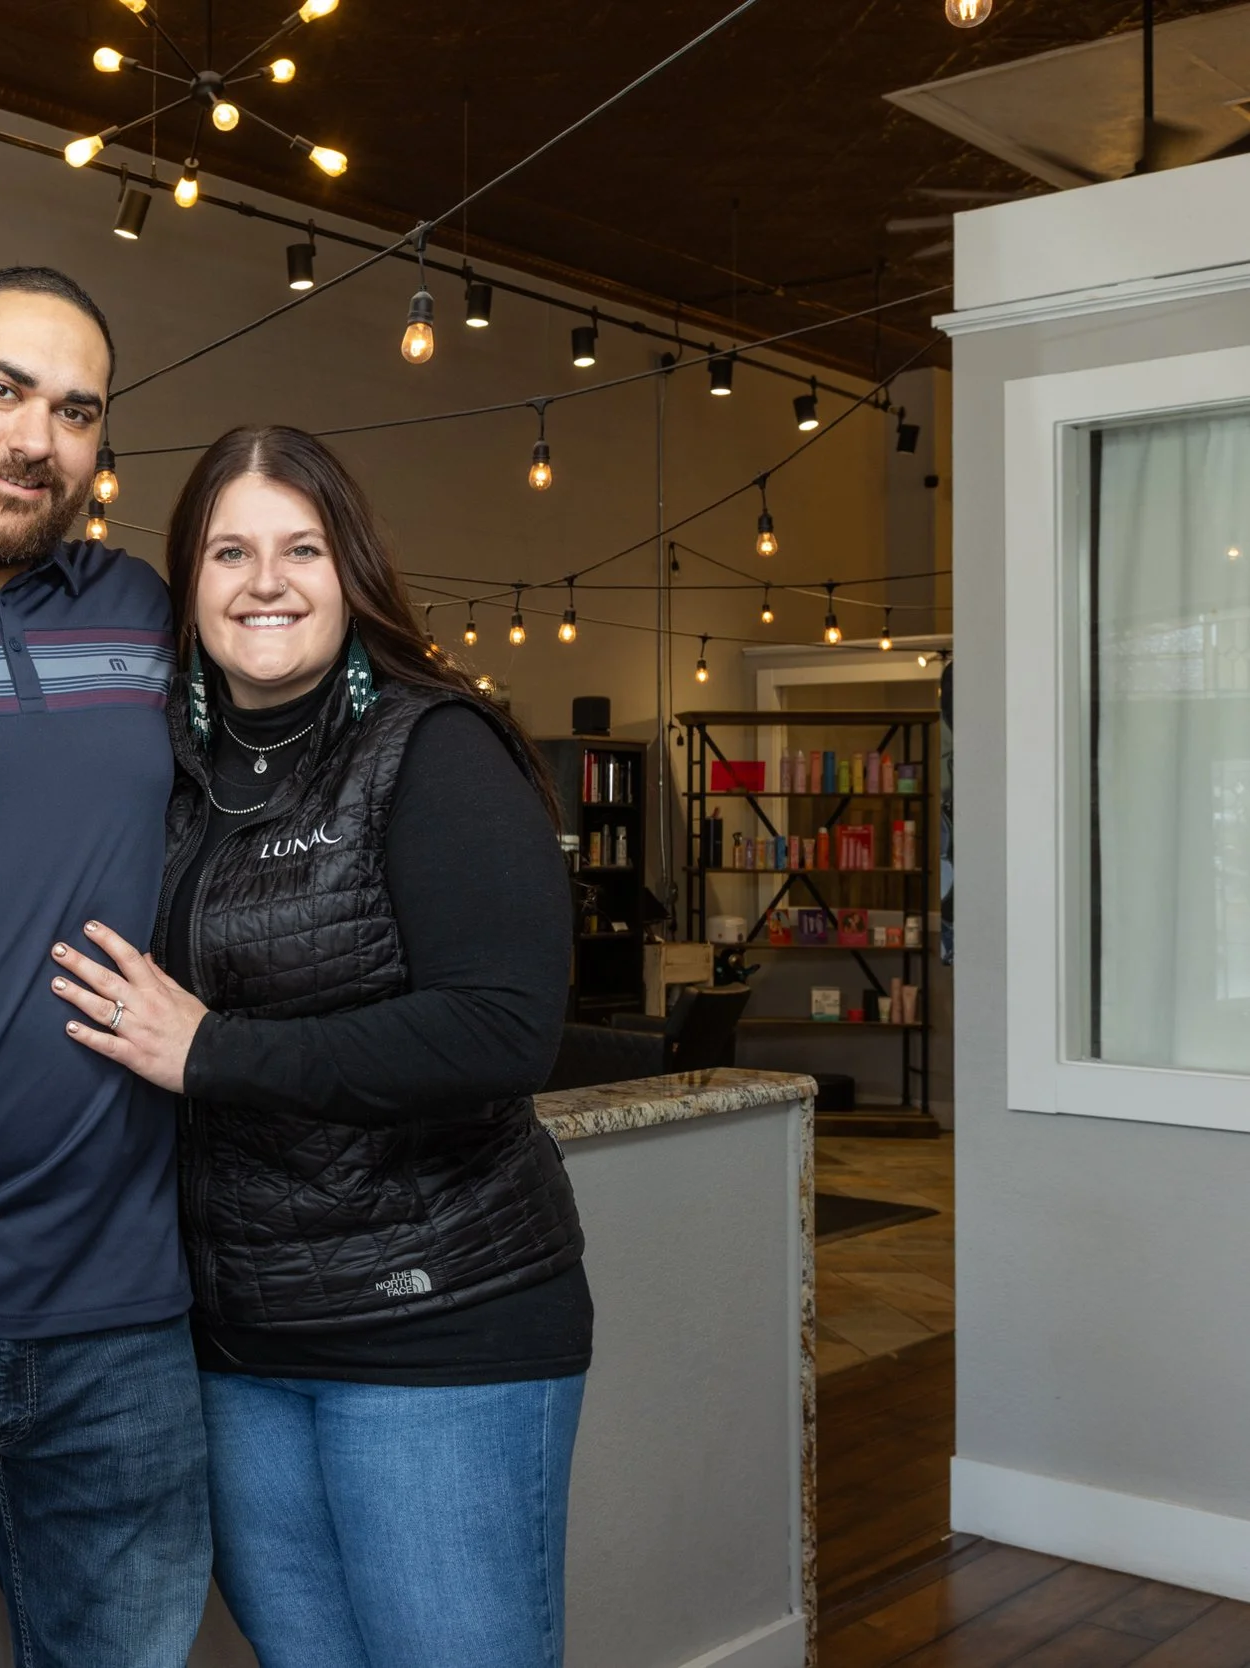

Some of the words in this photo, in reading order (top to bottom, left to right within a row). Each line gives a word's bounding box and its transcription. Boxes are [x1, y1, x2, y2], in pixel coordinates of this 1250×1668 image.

[390, 1270, 411, 1280] THE
[375, 1277, 412, 1291] NORTH
[387, 1286, 413, 1297] FACE
